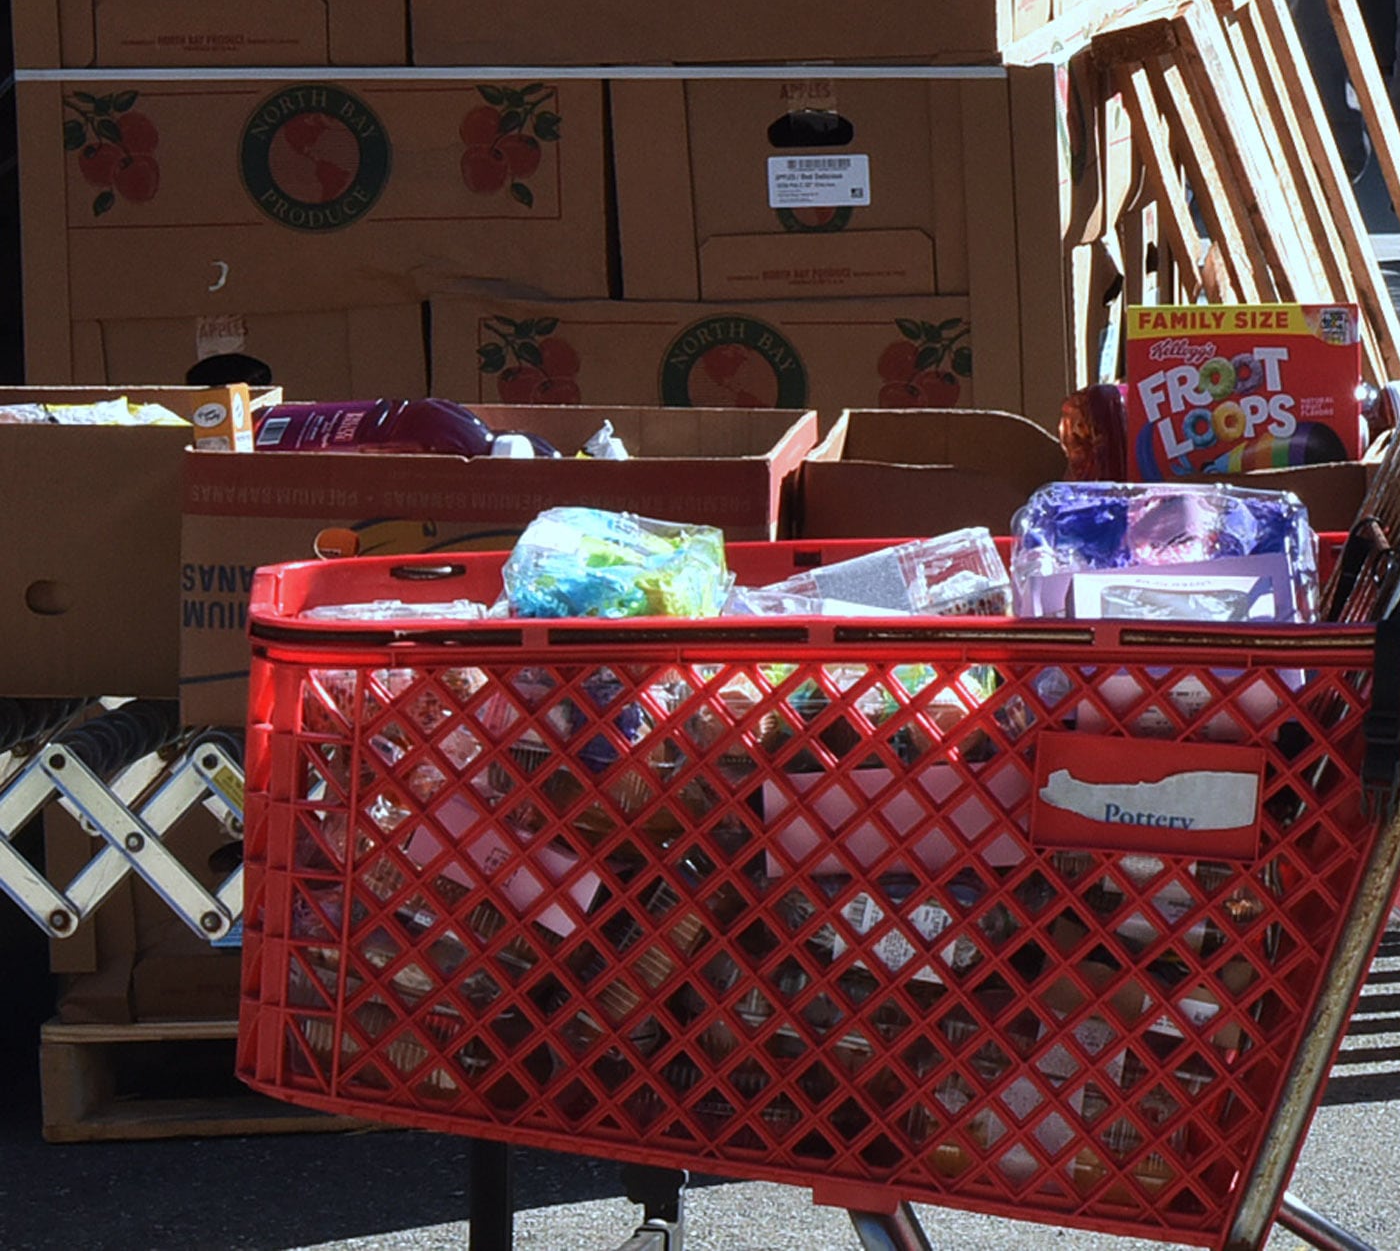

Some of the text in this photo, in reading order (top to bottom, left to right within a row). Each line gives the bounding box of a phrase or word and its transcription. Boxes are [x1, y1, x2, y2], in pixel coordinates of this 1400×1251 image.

[780, 83, 830, 100] APPLES
[250, 89, 376, 141] NORTH BAY
[260, 186, 370, 227] PRODUCE
[1138, 311, 1290, 330] FAMILY SIZE
[669, 322, 797, 372] NORTH BAY
[1150, 338, 1217, 363] Kellogg's
[1137, 347, 1289, 423] FROOT
[1157, 394, 1297, 460] LOOPS
[1105, 803, 1195, 830] Pottery
